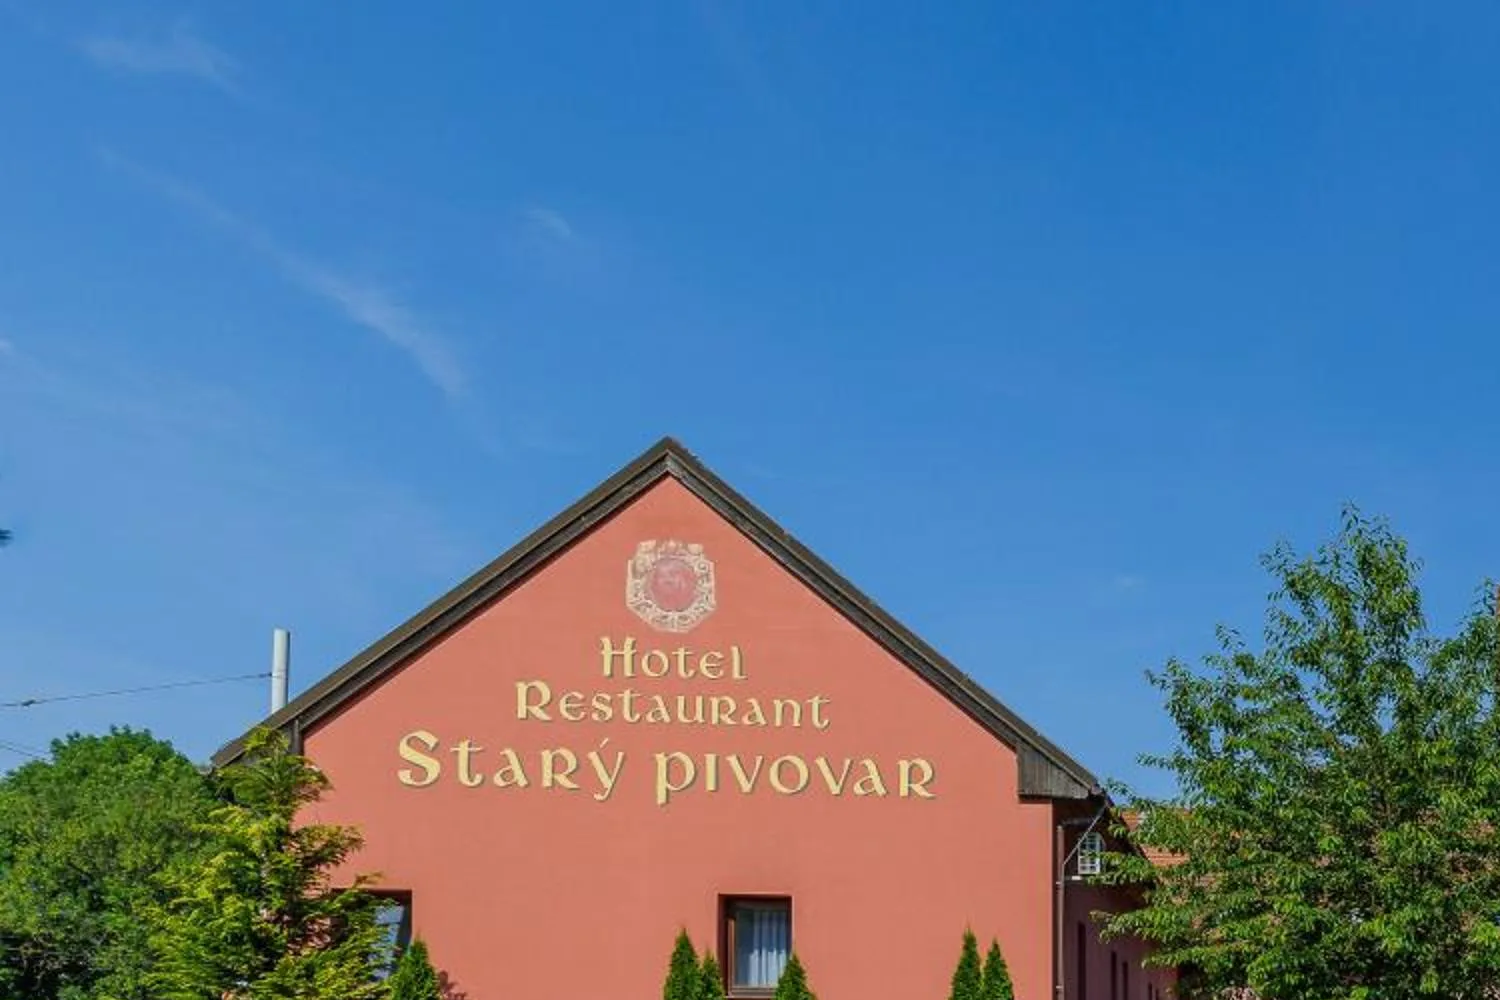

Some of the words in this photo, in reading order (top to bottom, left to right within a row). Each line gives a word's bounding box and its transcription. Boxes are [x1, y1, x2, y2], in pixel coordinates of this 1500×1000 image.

[600, 636, 747, 680] Hotel
[515, 680, 832, 729] Restaurant
[396, 730, 626, 801] Starý
